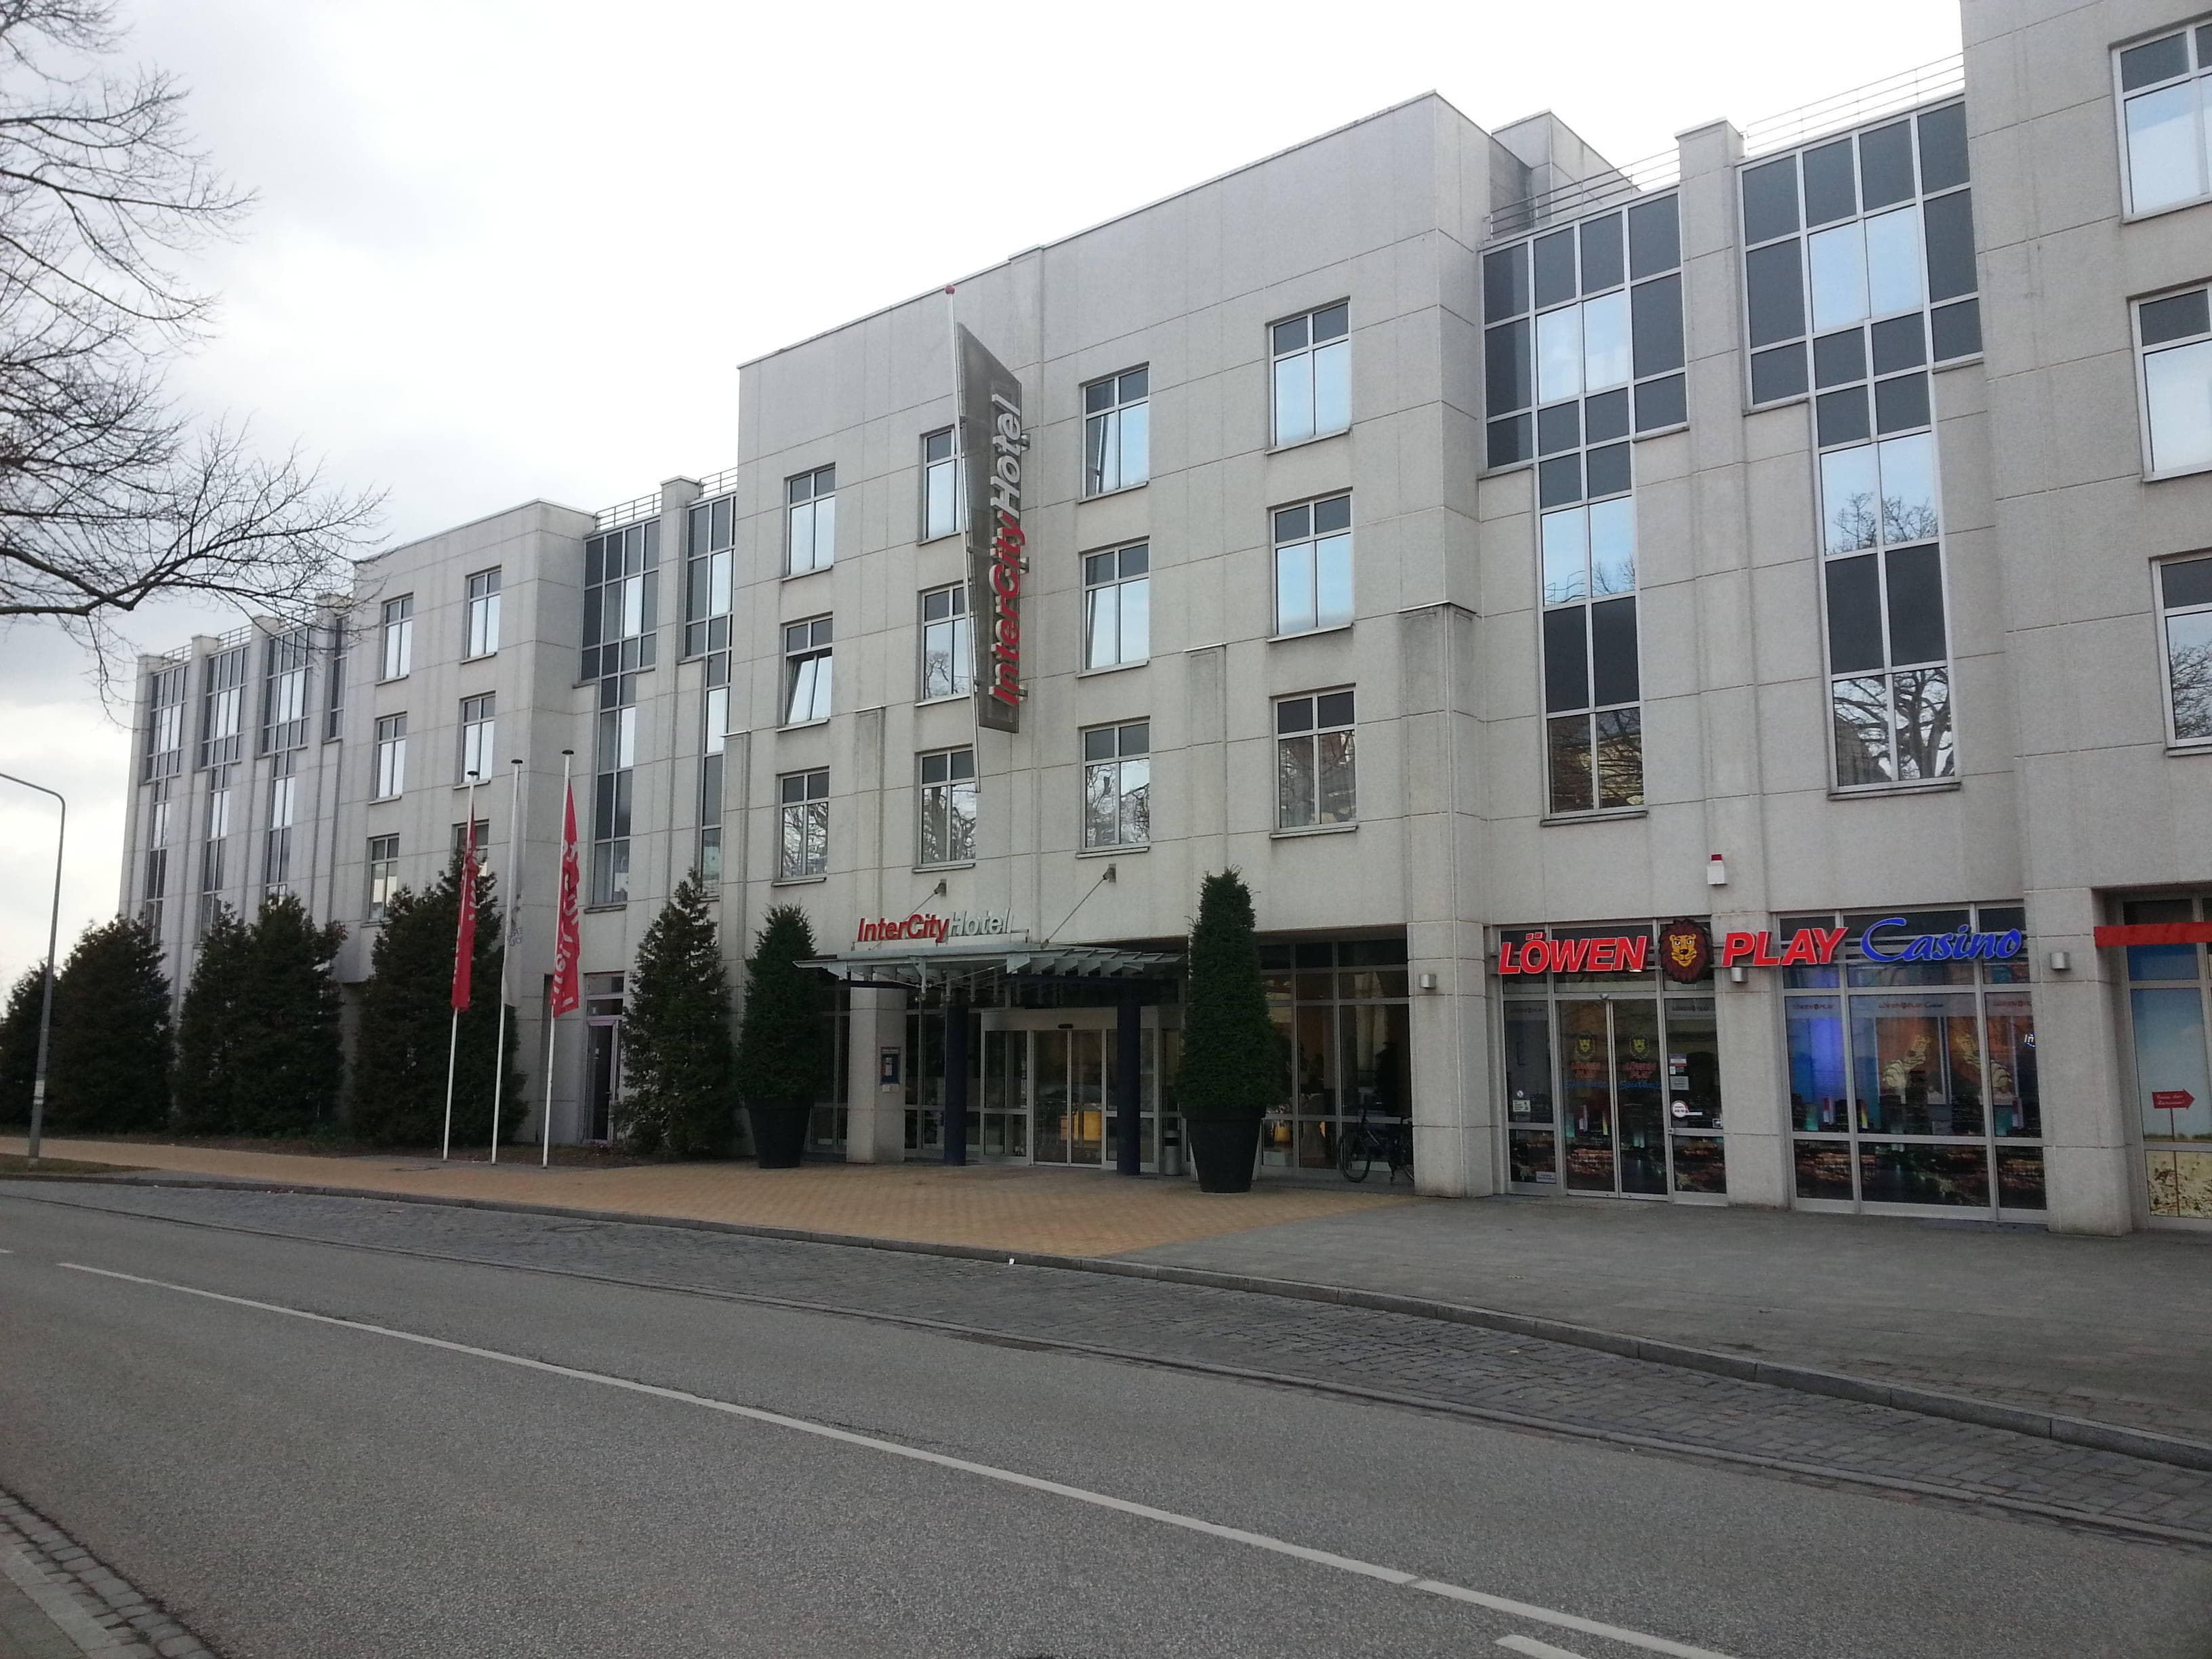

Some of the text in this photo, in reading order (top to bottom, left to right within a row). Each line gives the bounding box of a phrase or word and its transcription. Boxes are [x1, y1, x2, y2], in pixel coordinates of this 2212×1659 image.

[989, 393, 1025, 705] InterCityHotel
[857, 907, 1014, 943] InterCityHotel
[1498, 917, 2023, 975] LÖWEN PLAY Casino
